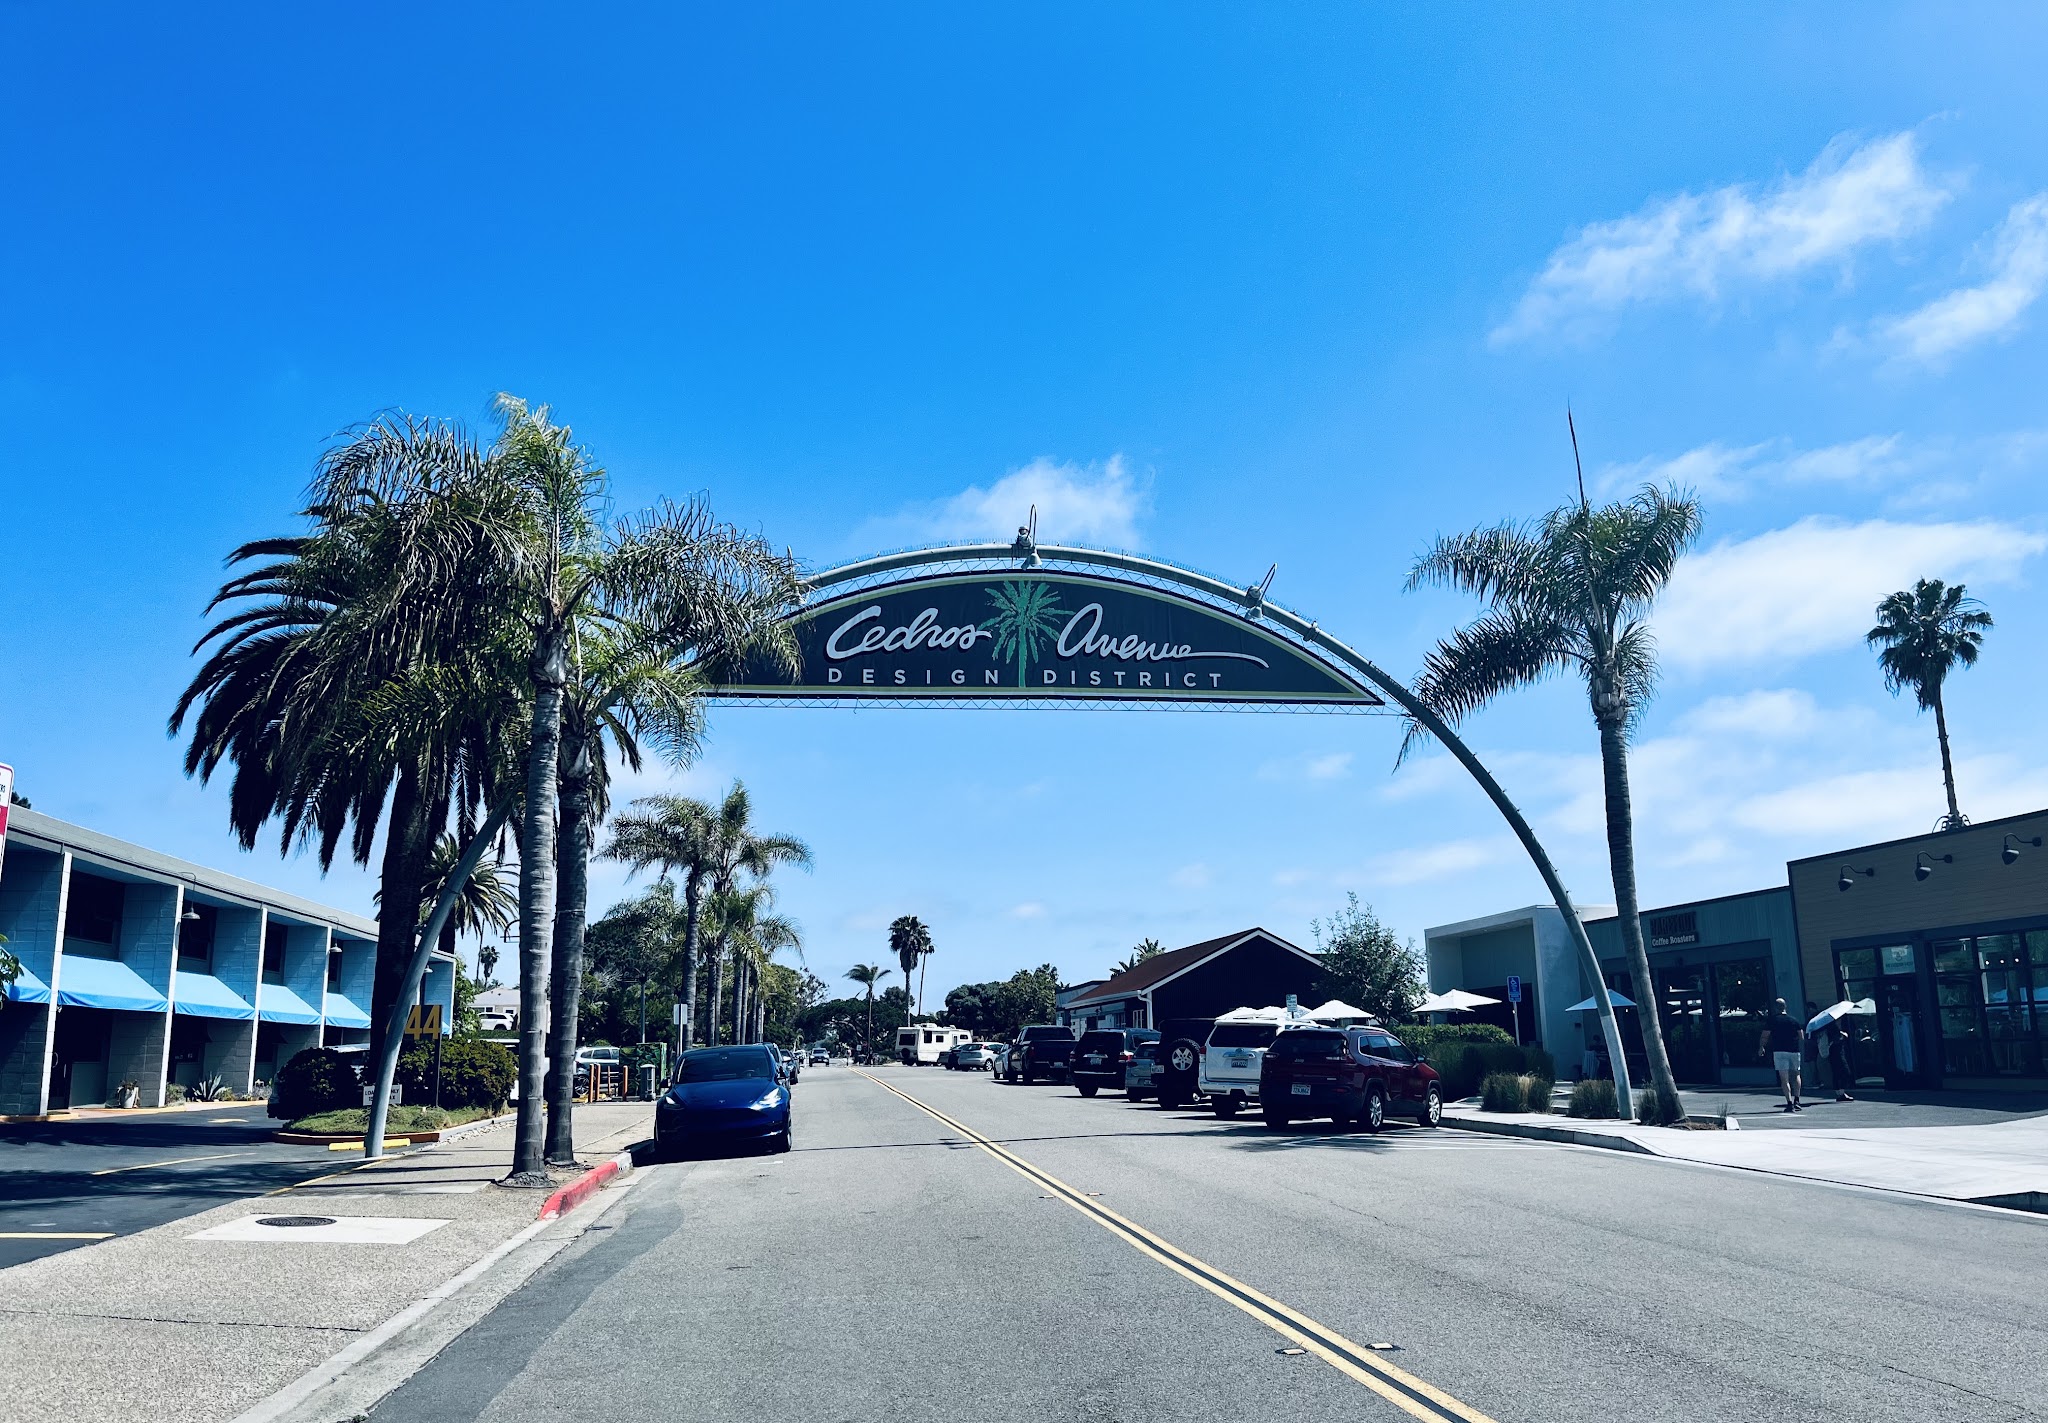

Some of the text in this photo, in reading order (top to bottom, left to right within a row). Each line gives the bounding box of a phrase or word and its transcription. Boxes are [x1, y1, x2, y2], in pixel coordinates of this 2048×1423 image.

[826, 603, 1269, 668] Cedros Avenue
[828, 668, 1222, 687] DESIGN DISTRICT
[1652, 934, 1695, 947] Coffee Roasters
